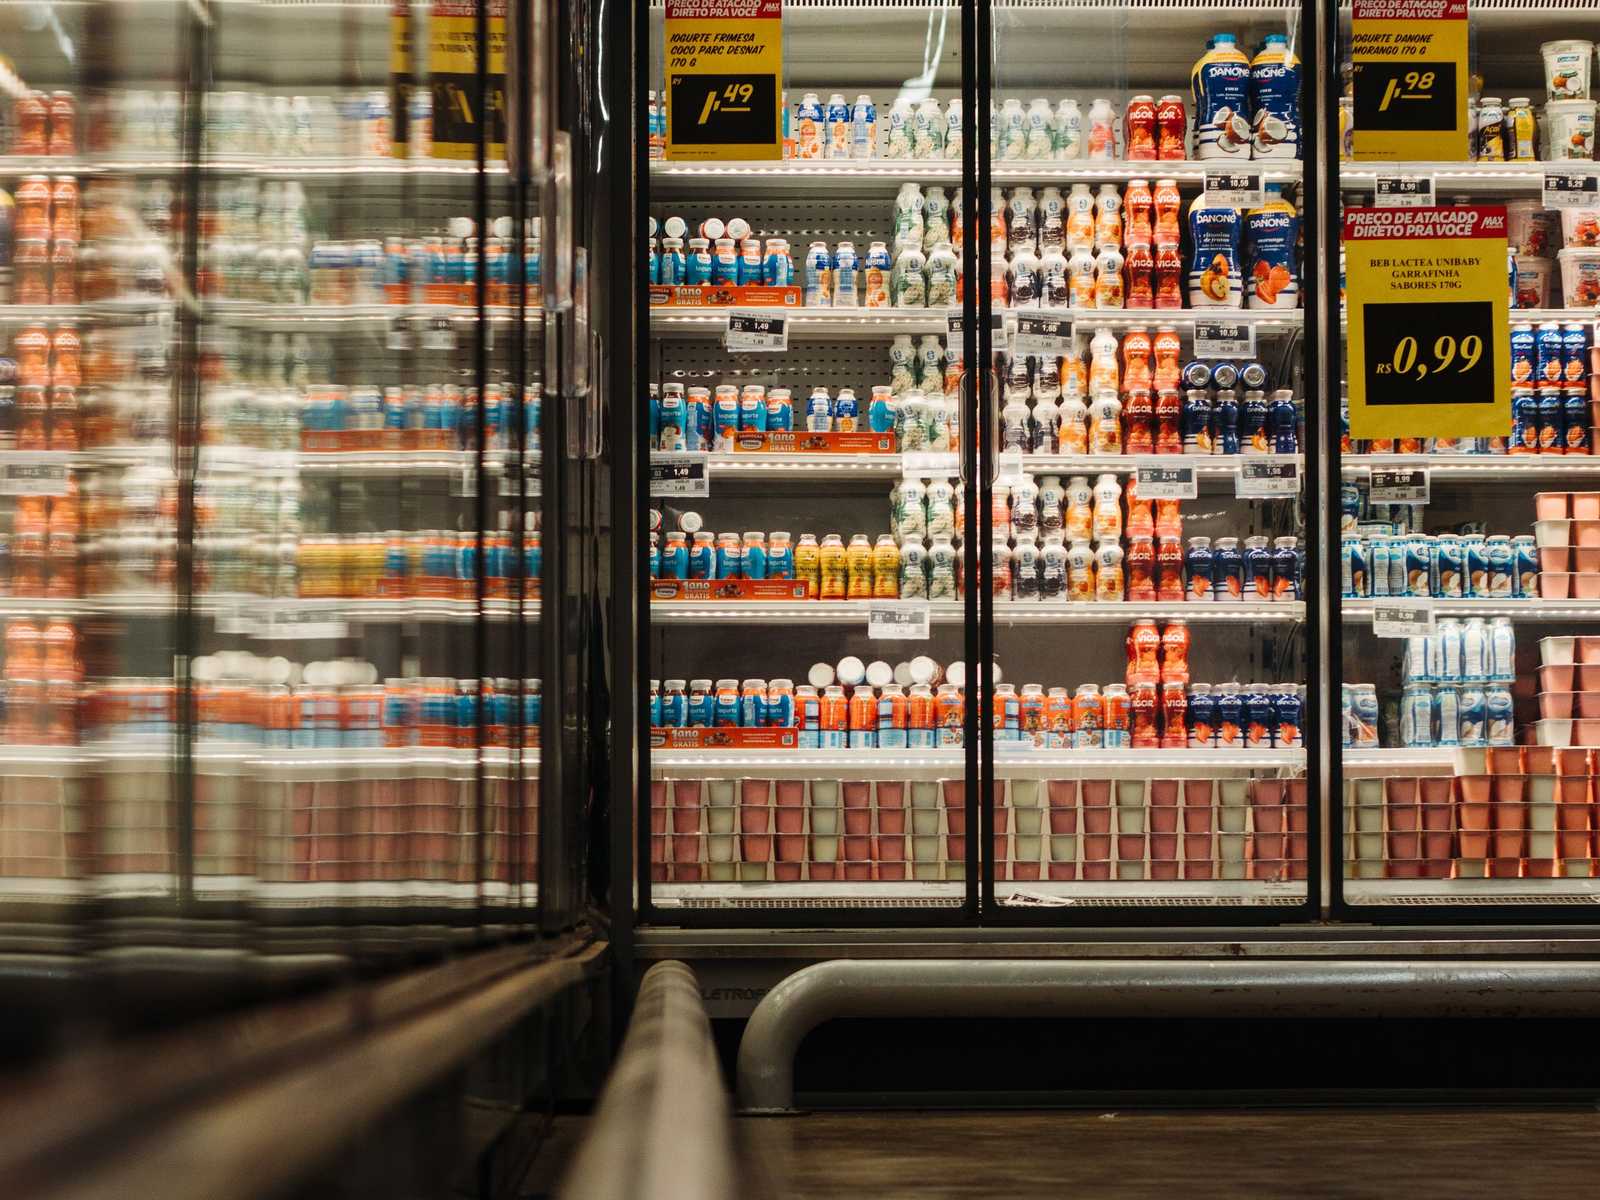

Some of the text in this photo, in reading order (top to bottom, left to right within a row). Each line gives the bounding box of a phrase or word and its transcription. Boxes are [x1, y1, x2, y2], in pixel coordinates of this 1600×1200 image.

[1354, 0, 1448, 10] PREÇO DE ATACADO
[672, 8, 708, 16] DIRETO
[710, 8, 730, 16] PRA
[1358, 9, 1395, 17] DIRETO
[1396, 9, 1417, 17] PRA
[670, 33, 755, 42] IOGURTE FRIMESA
[1352, 34, 1434, 43] IOGURTE DANONE
[670, 46, 765, 55] COCO PARC DESNAT
[1352, 46, 1400, 55] MORANGO
[1401, 46, 1416, 55] 170
[671, 58, 687, 67] 170
[1253, 67, 1285, 78] ANONE
[1347, 212, 1478, 226] PREÇO DE ATACADO
[1481, 216, 1504, 229] MAX
[1353, 225, 1404, 237] DIRETO
[1406, 224, 1436, 236] PRA
[1370, 259, 1390, 268] BEB
[1436, 257, 1481, 266] UNIBABY
[1392, 270, 1460, 278] GARRAFINHA
[1391, 281, 1462, 290] SABORES 170G
[1394, 335, 1483, 381] 0,99
